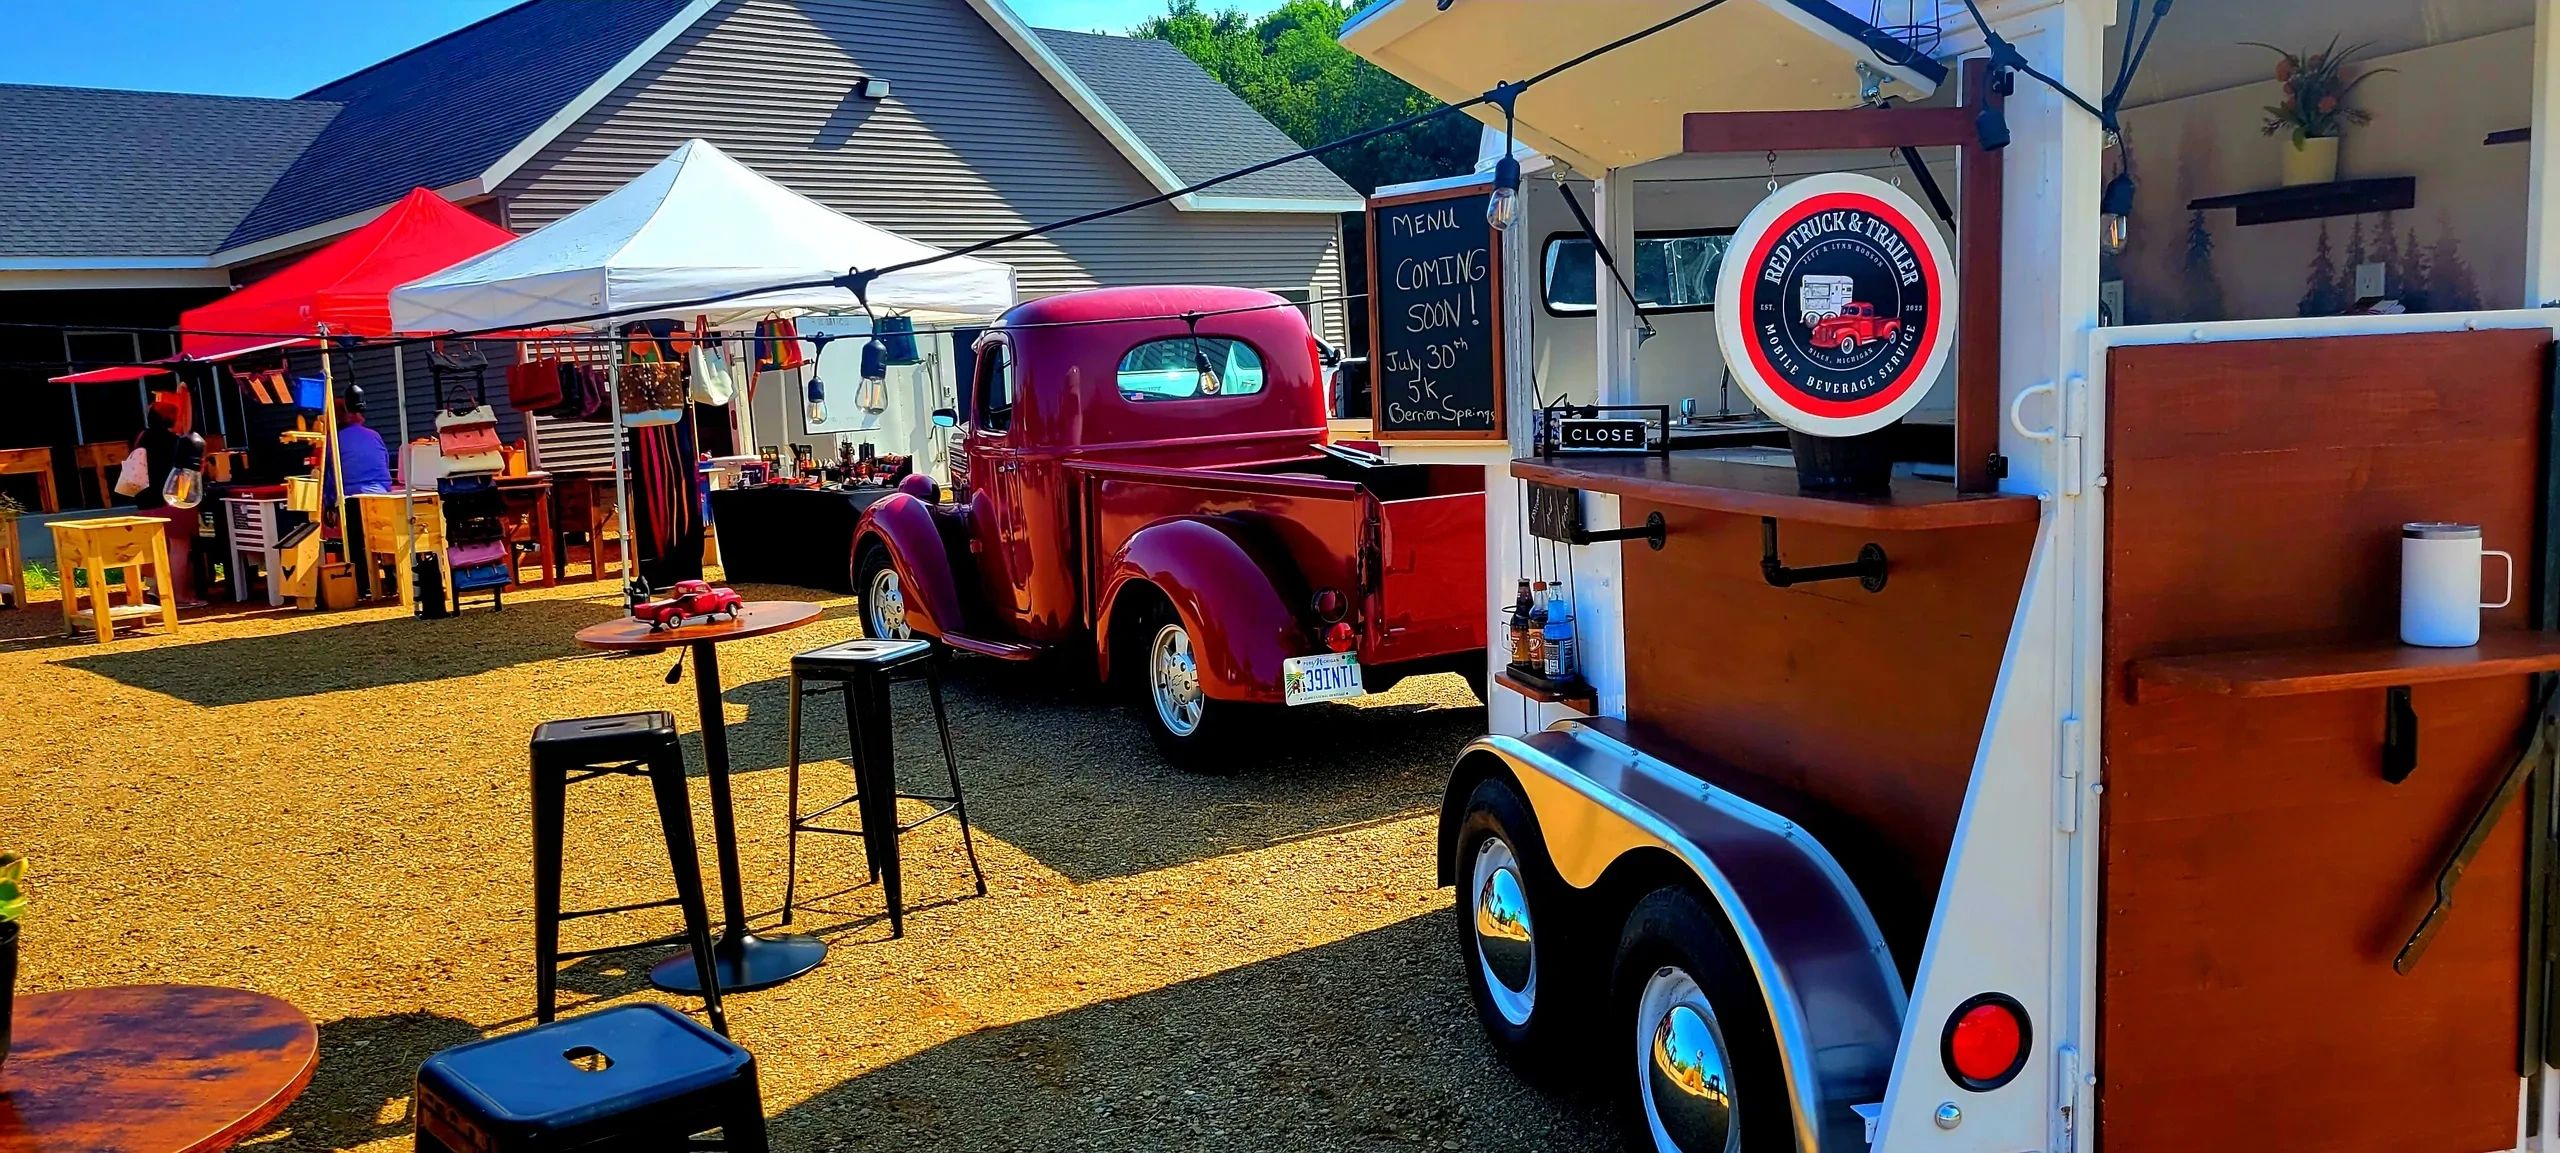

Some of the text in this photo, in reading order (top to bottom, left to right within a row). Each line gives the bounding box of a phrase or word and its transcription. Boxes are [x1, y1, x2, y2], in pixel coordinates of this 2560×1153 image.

[1392, 207, 1460, 237] MENU
[1764, 211, 1919, 287] RED TRUCK & TRAILER
[1396, 248, 1487, 291] COMING
[1386, 349, 1422, 381] July
[1765, 324, 1916, 394] MOBILE BEVERAGE SERVICE
[1571, 428, 1635, 442] CLOSE
[1306, 665, 1358, 692] 39INTL
